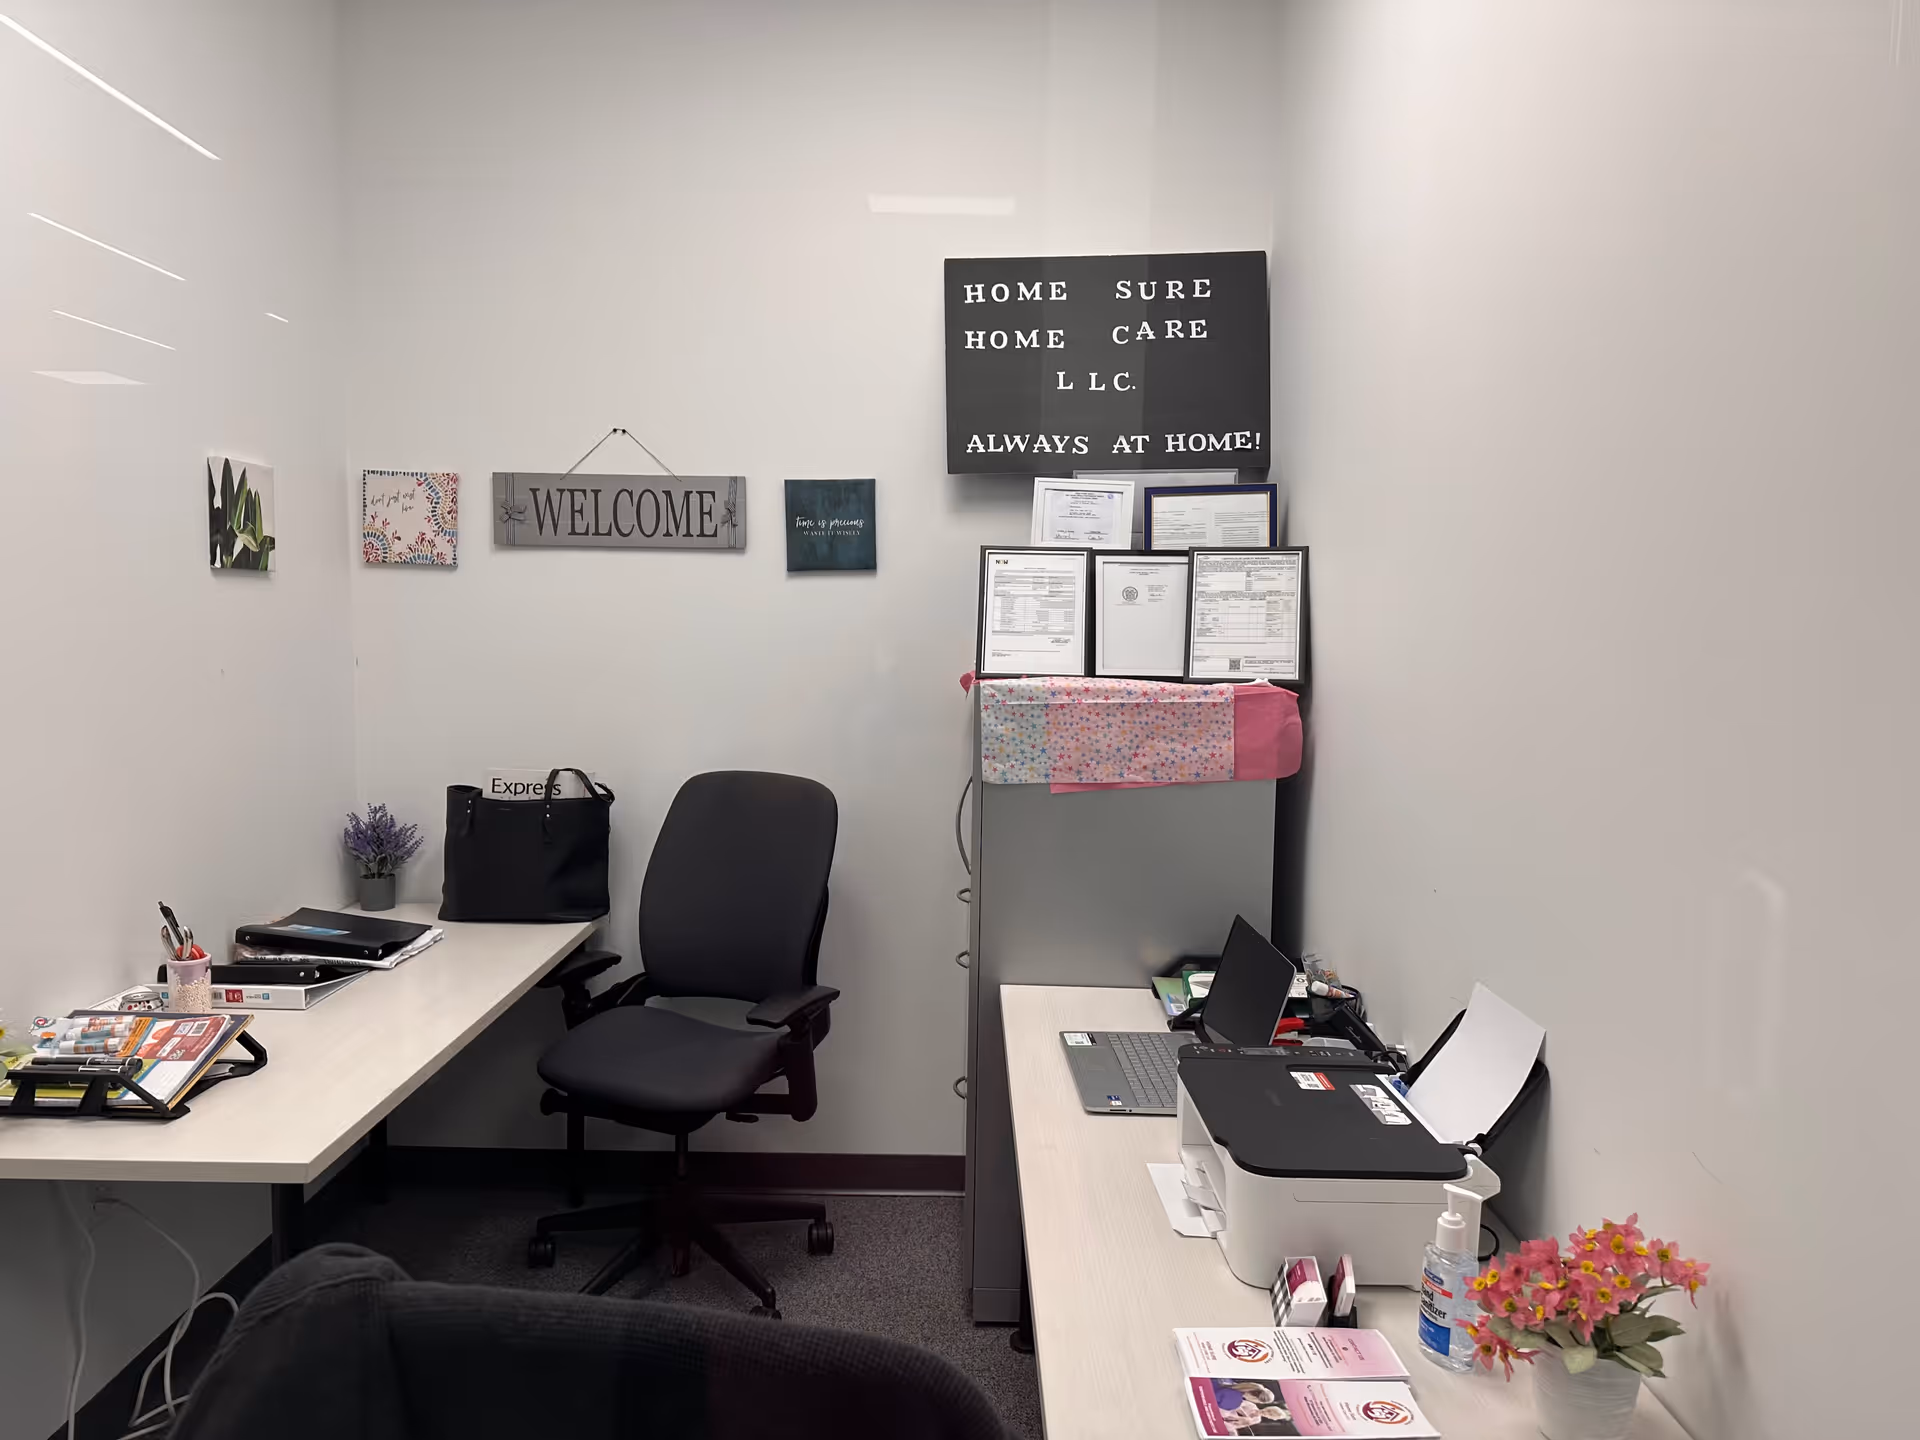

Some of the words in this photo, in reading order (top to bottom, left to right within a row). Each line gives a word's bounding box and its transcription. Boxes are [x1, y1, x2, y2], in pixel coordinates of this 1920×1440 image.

[964, 281, 1067, 303] HOME
[1115, 279, 1212, 300] SURE
[964, 329, 1065, 349] HOME
[1112, 319, 1208, 344] CARE
[966, 433, 1089, 455] ALWAYS
[1112, 434, 1150, 453] AT
[1165, 430, 1261, 452] HOME!
[386, 489, 400, 507] just
[529, 487, 718, 538] WELCOME
[818, 519, 827, 529] is
[829, 518, 865, 530] precious
[491, 777, 562, 796] Expres
